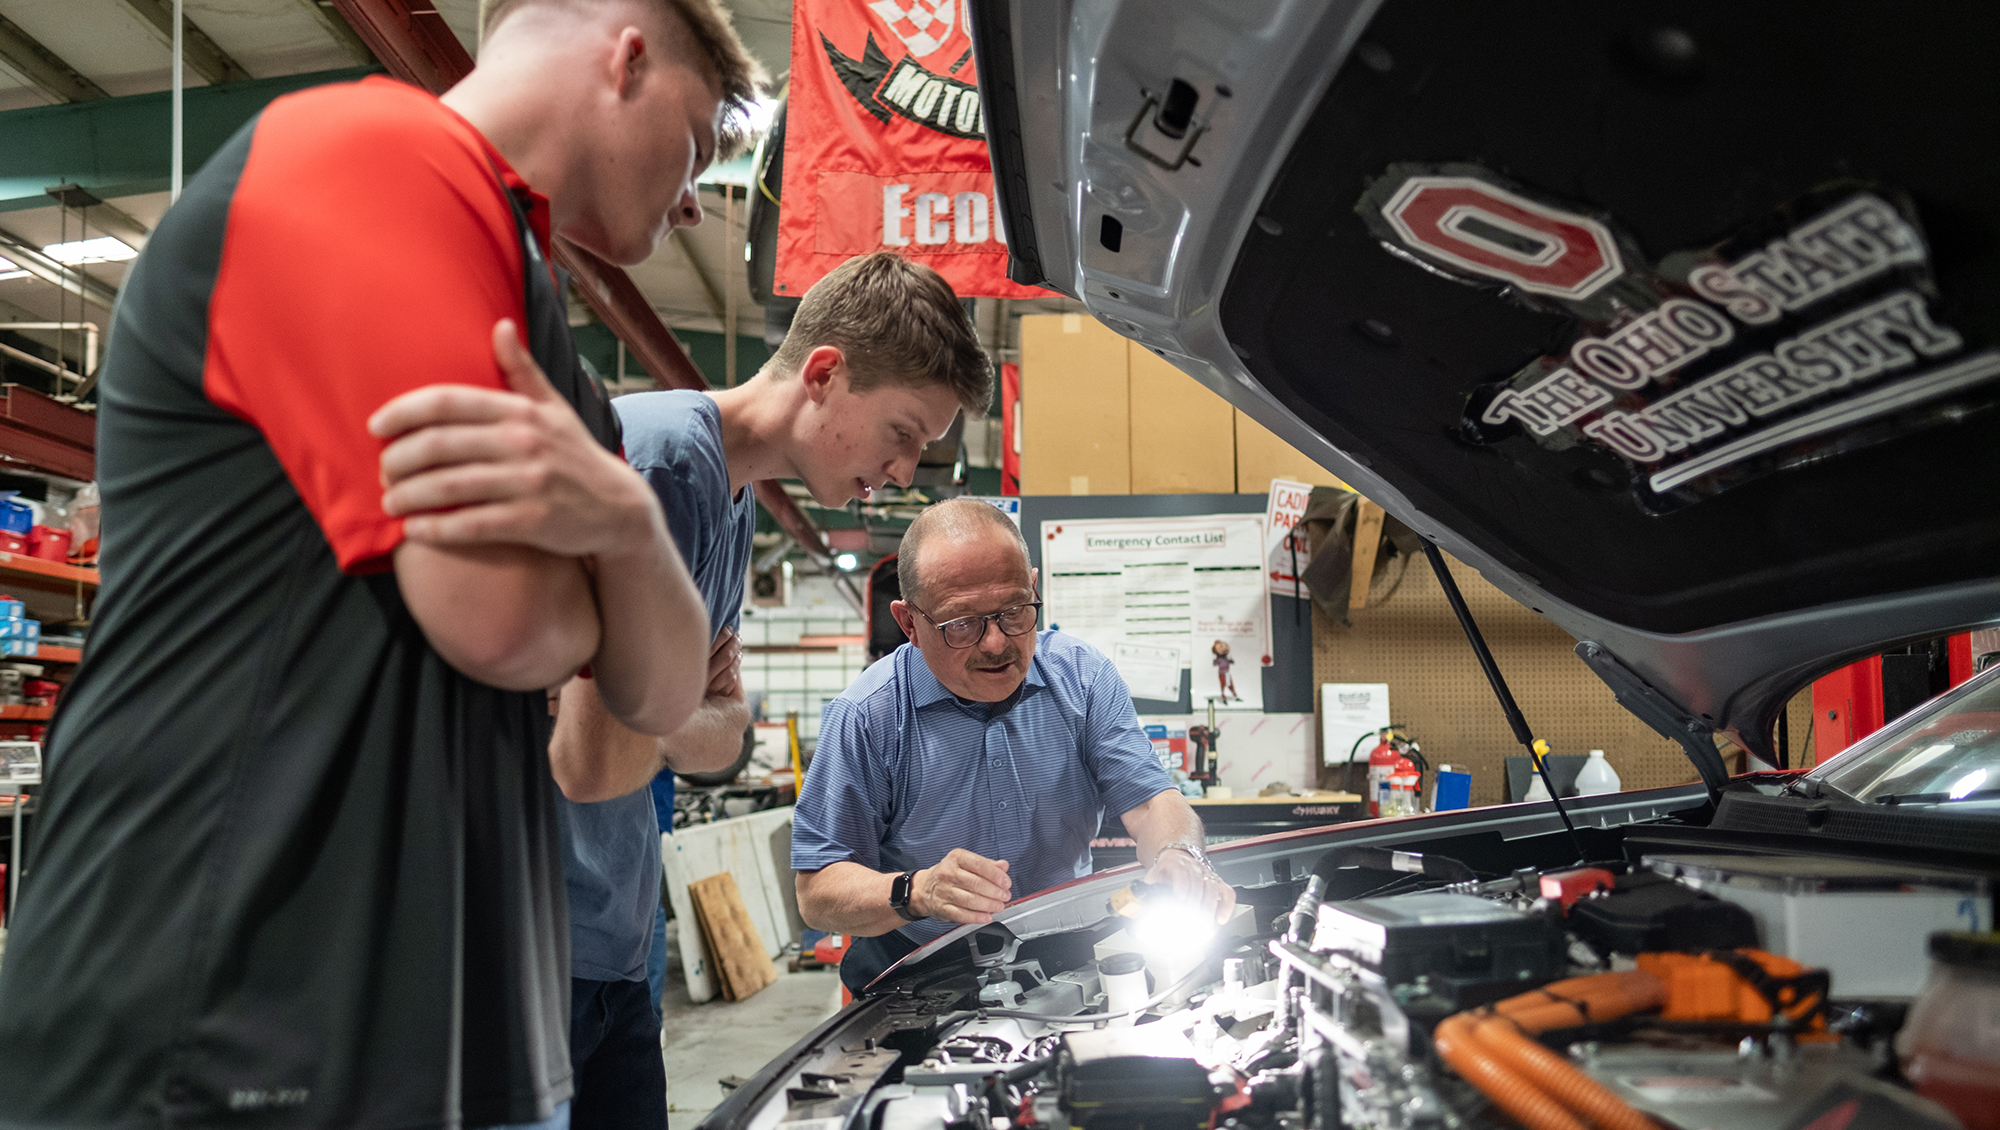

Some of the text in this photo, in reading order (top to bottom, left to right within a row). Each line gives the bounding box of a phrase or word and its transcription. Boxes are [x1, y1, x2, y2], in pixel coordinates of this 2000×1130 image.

[1482, 193, 1925, 436] THE OHIO STATE
[1583, 291, 1963, 461] UNIVERSITY
[1087, 533, 1223, 549] Emergency Contact List
[1305, 805, 1340, 816] HUSKY
